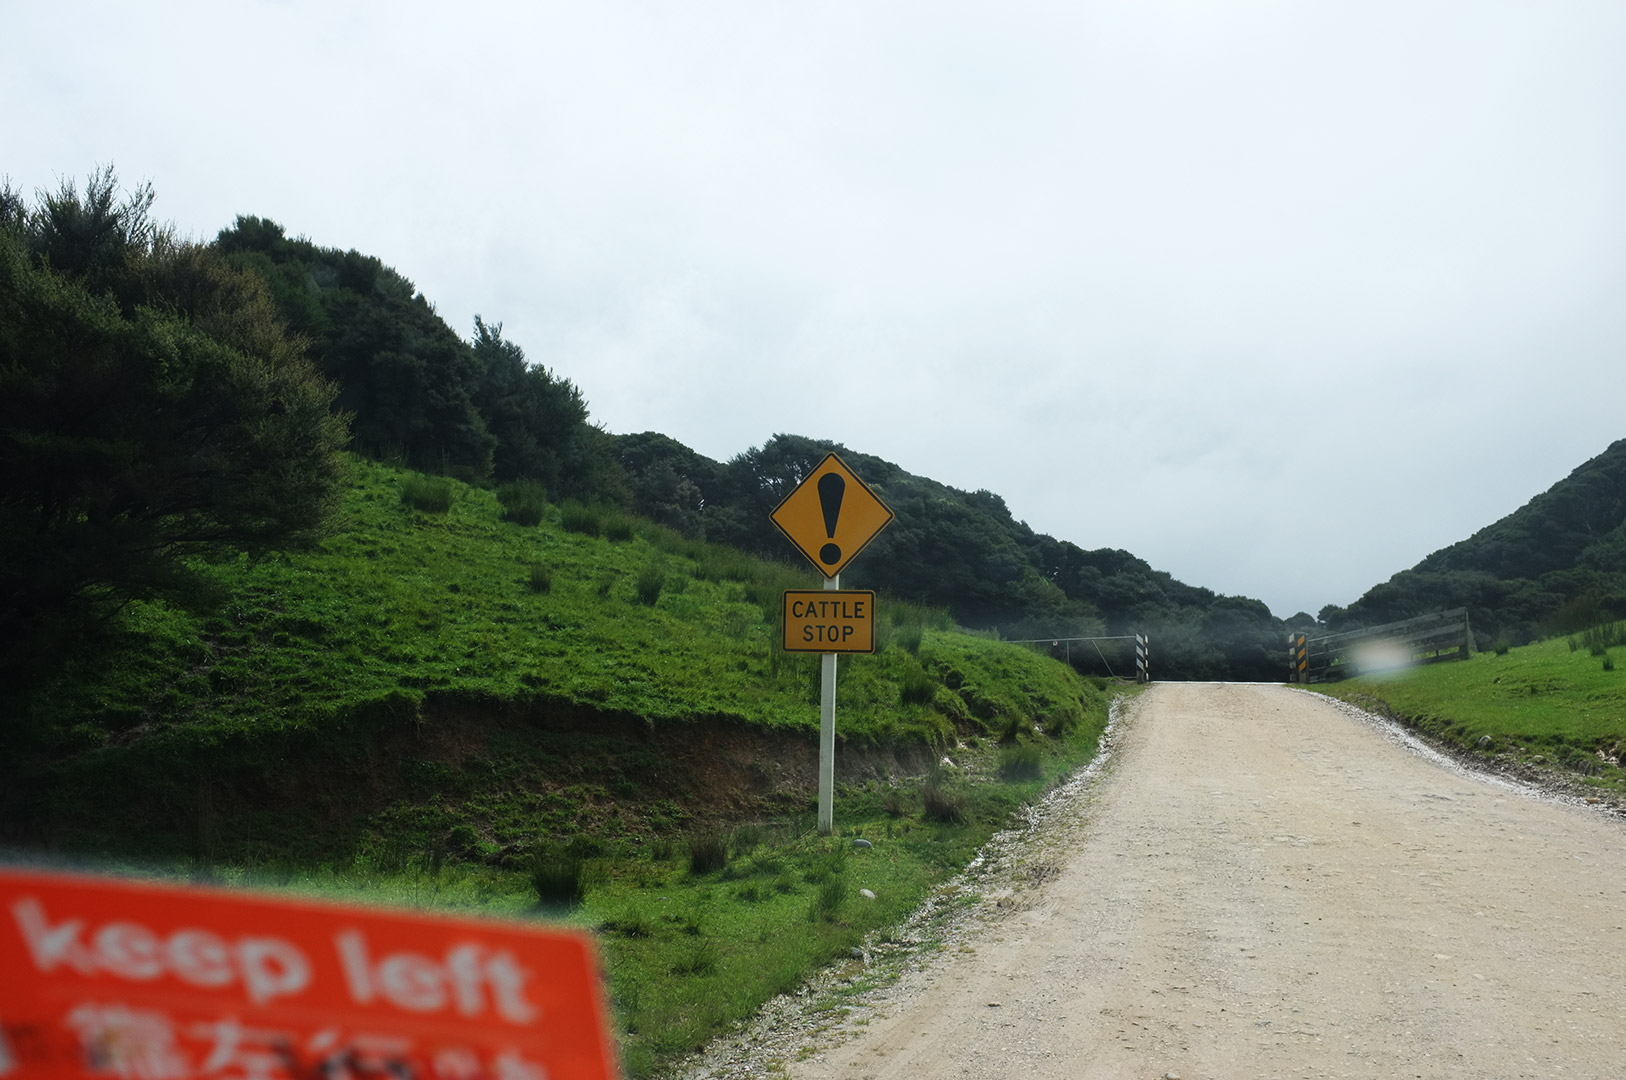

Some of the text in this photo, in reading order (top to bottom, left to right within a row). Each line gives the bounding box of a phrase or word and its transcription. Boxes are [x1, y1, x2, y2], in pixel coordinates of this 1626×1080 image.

[792, 601, 865, 619] CATTLE
[803, 625, 854, 643] STOP
[12, 896, 540, 1024] keep left
